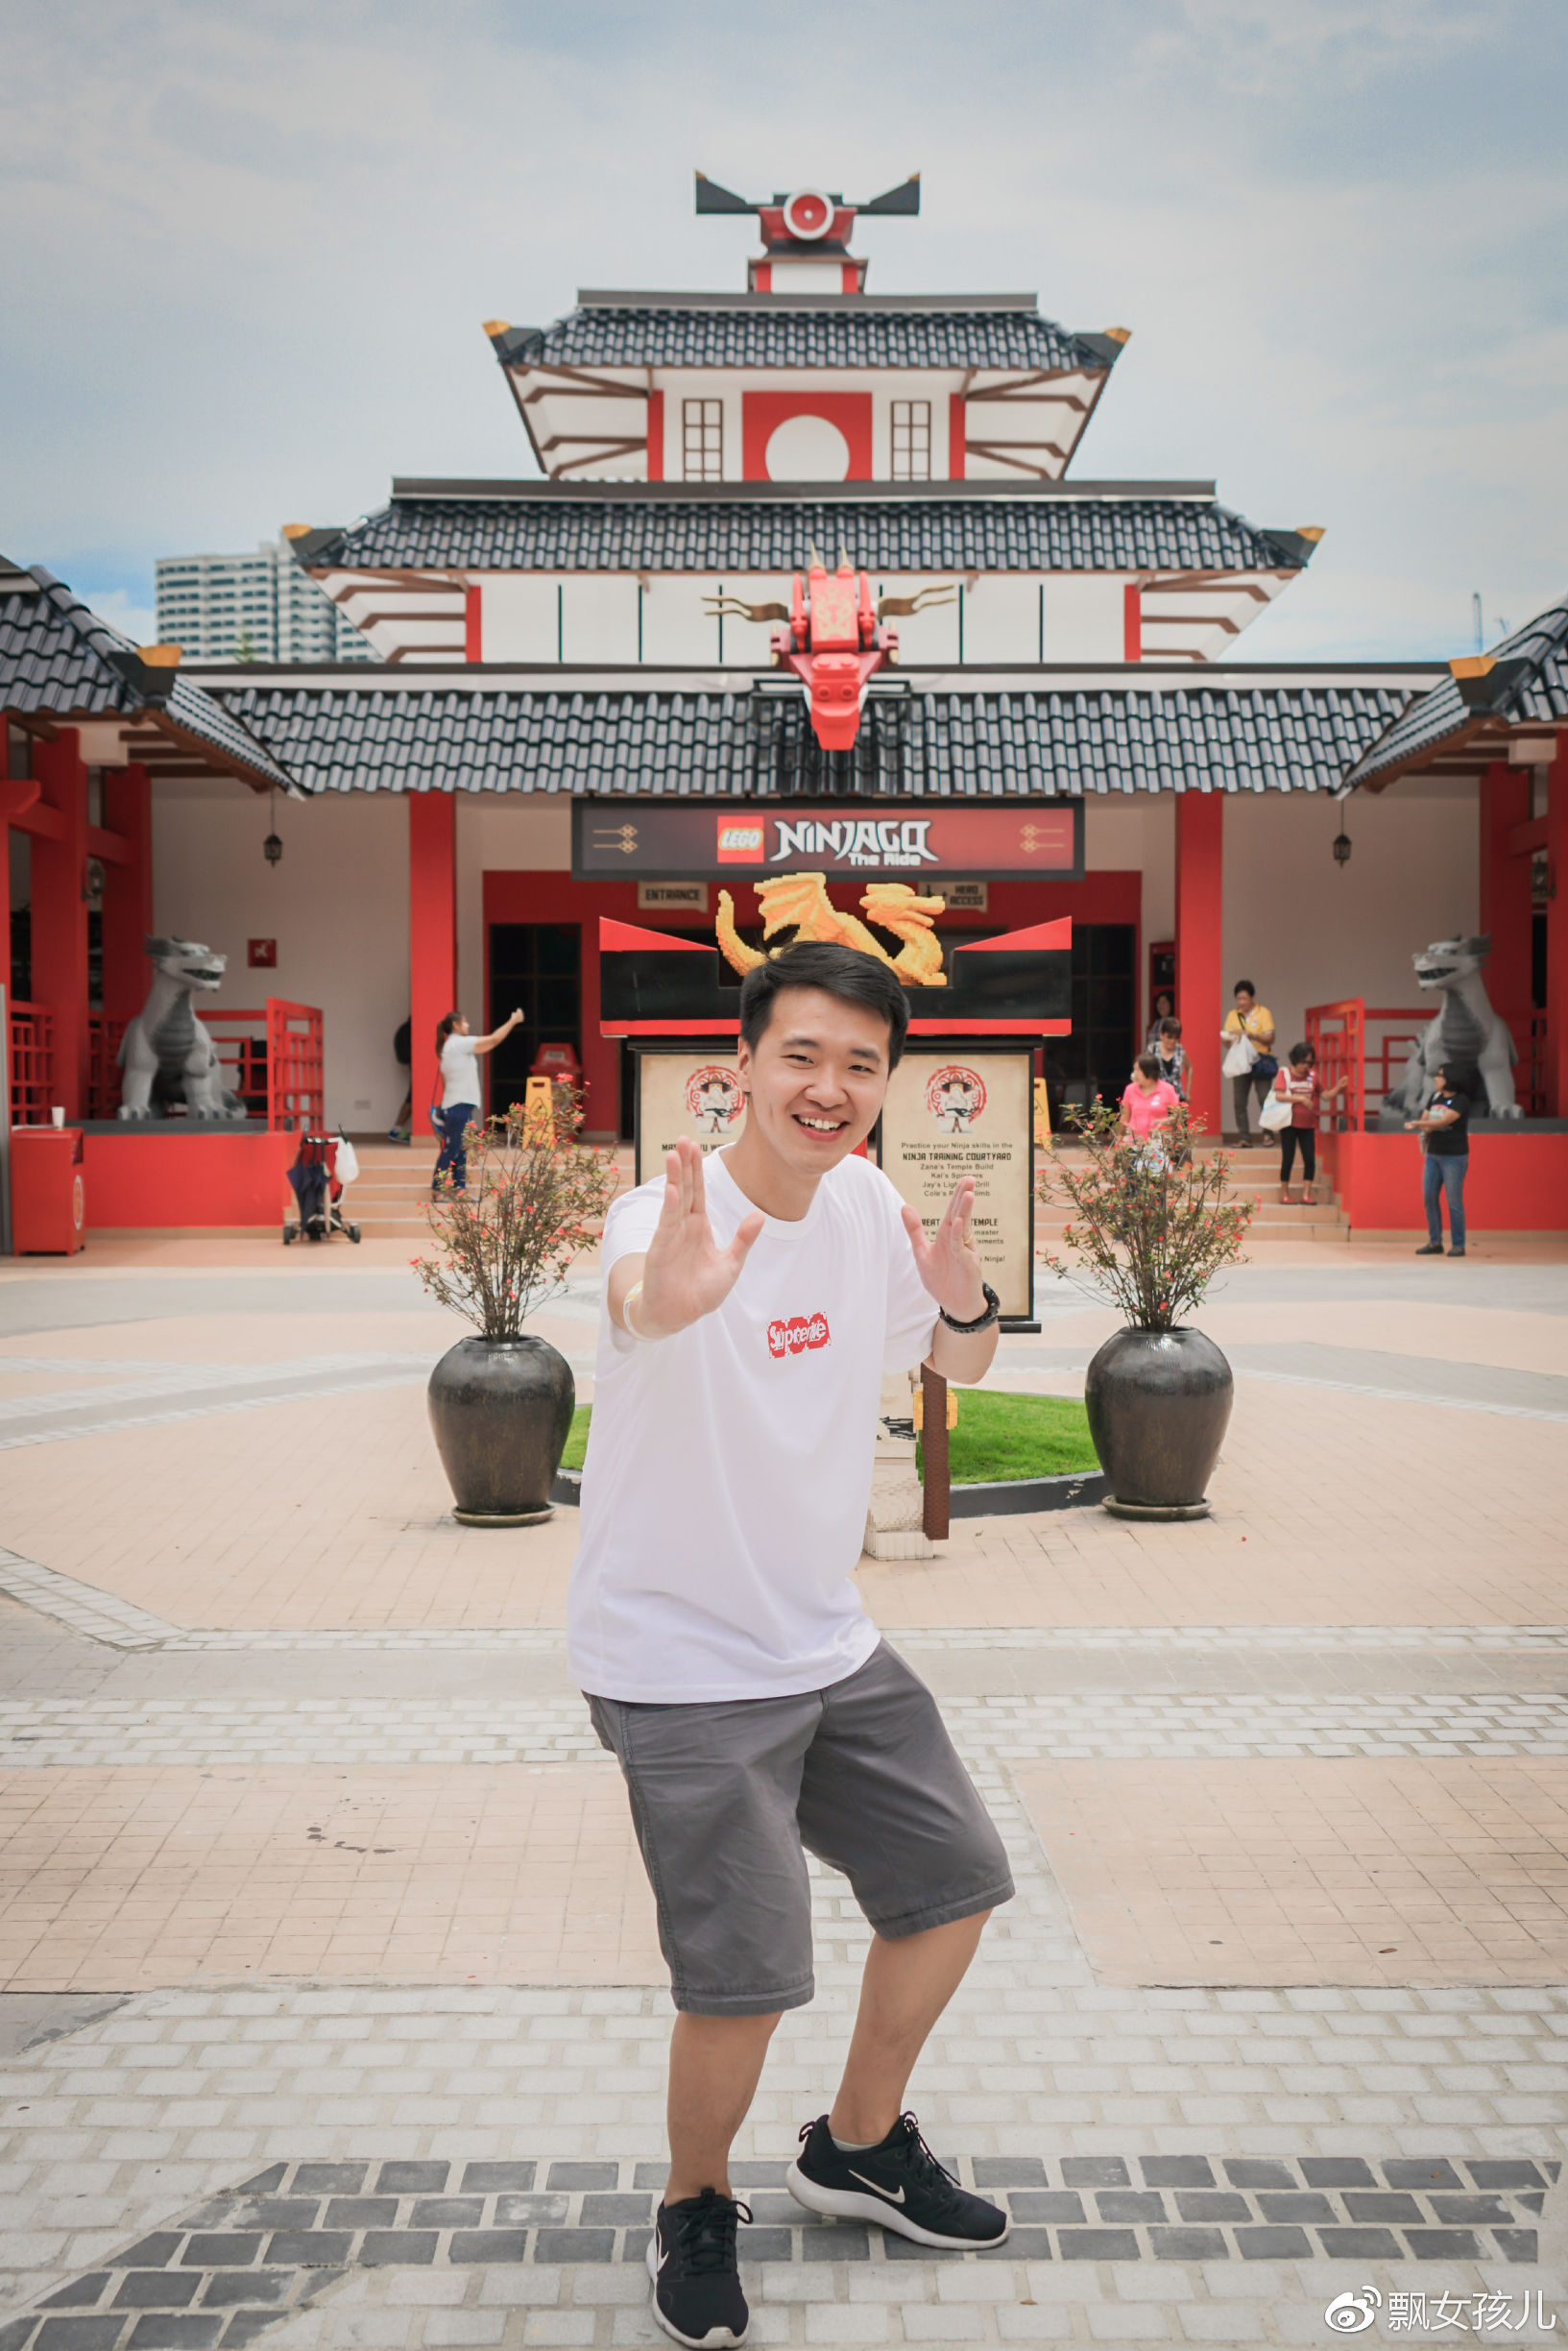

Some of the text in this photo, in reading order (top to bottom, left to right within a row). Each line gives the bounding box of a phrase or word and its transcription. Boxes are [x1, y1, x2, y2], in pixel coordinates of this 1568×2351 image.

[720, 829, 762, 850] LEGO
[769, 820, 940, 862] NINJAGO
[848, 852, 922, 866] The Ride
[644, 888, 700, 901] ENTRANCE
[951, 1142, 970, 1151] Ninja
[902, 1152, 1013, 1161] NINJA TRAINING COURTYARD
[947, 1163, 973, 1172] Temple
[769, 1320, 827, 1353] Supreme
